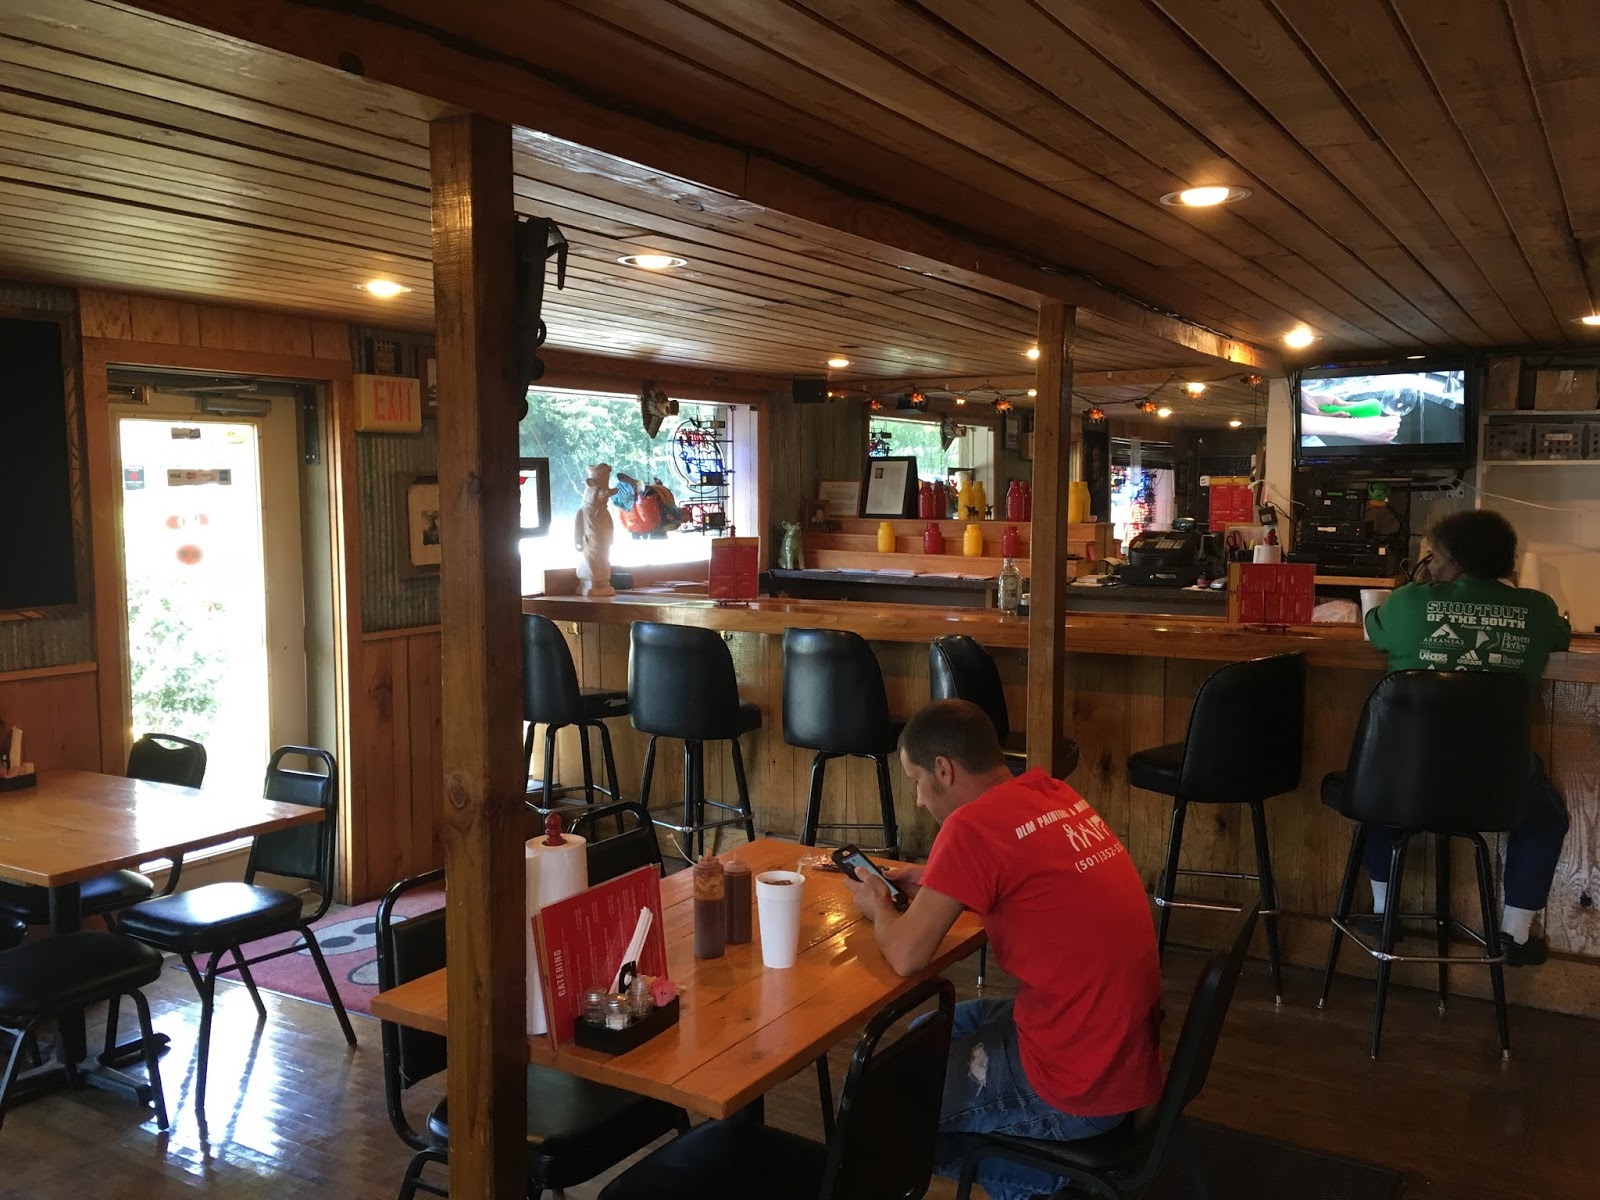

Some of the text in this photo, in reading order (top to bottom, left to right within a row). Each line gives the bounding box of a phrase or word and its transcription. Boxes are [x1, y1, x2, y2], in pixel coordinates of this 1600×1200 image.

[373, 380, 413, 421] EXIT
[1427, 601, 1528, 620] SHOOTOUT
[1427, 613, 1526, 629] OF THE SOUTH
[1423, 637, 1465, 646] ARKANSAS
[1503, 632, 1530, 644] Bowen
[1419, 652, 1448, 661] LANDERS
[1457, 658, 1482, 666] adidas
[1015, 820, 1036, 840] DLM
[553, 949, 566, 997] CATERING
